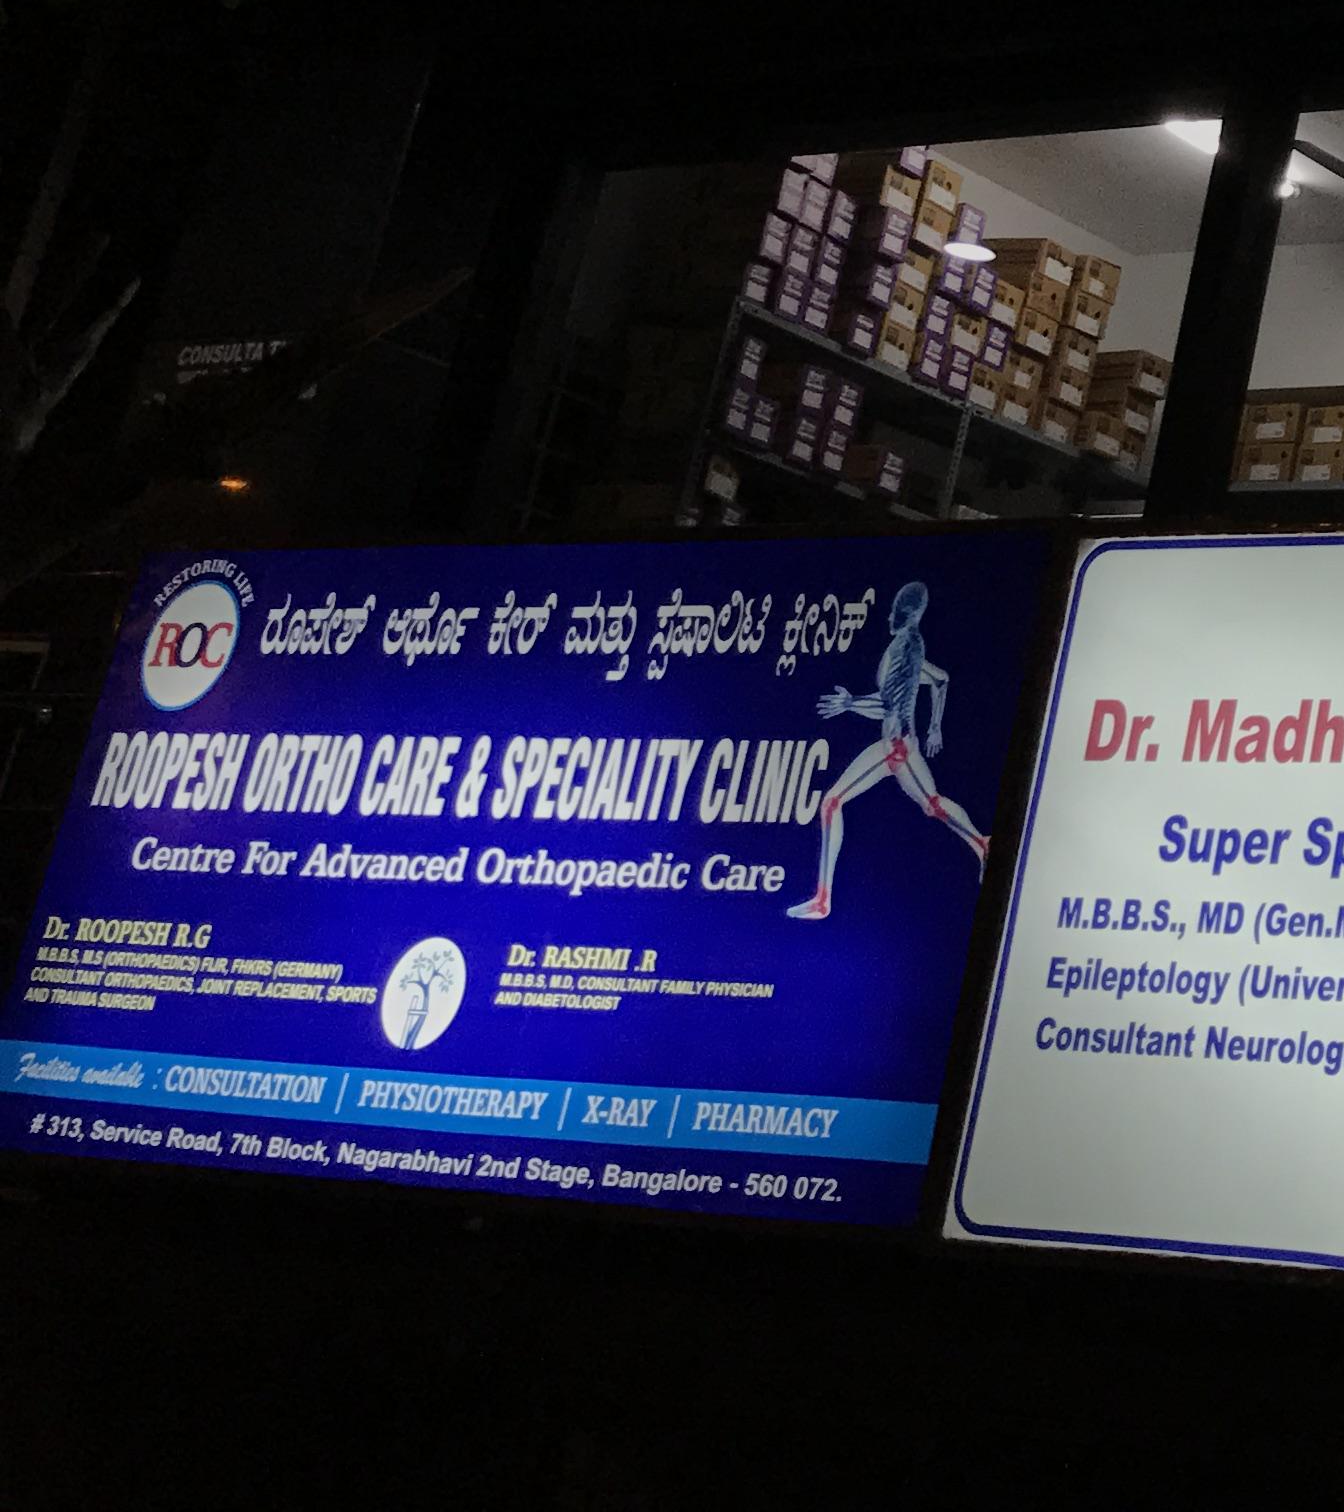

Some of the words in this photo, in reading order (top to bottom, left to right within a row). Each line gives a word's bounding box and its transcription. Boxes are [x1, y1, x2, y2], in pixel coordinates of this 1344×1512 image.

[153, 559, 238, 607] RESTORING
[233, 571, 256, 608] LIFE
[148, 622, 234, 668] ROC
[1085, 699, 1157, 761] Dr.
[90, 730, 251, 812] ROOPESH
[242, 732, 364, 816] ORTHO
[358, 734, 463, 817] CARE
[454, 734, 492, 819] &
[490, 735, 704, 822] SPECIALITY
[698, 737, 830, 826] CLINIC
[131, 836, 236, 874] Centre
[240, 840, 298, 876] For
[298, 842, 470, 883] Advanced
[475, 847, 691, 897] Orthopaedic
[701, 853, 785, 892] Care
[1157, 813, 1292, 877] Super
[74, 917, 173, 946] ROOPESH
[172, 923, 213, 949] R.G
[1056, 895, 1185, 937] M.B.B.S.,
[1195, 900, 1246, 936] MD
[273, 960, 344, 984] (GERMANY)
[541, 945, 633, 971] RASHMI
[1045, 955, 1230, 1005] Epileptology
[30, 966, 105, 987] CONSULTANT
[233, 980, 324, 1004] REPLACEMENT,
[326, 985, 378, 1004] SPORTS
[50, 989, 98, 1007] TRAUMA
[98, 992, 157, 1011] SURGEON
[522, 992, 622, 1011] DIABETOLOGIST
[577, 974, 661, 994] CONSULTANT
[659, 979, 705, 996] FAMILY
[705, 981, 775, 999] PHYSICIAN
[1035, 1016, 1197, 1058] Consultant
[15, 1052, 78, 1083] Facilities
[165, 1065, 327, 1103] CONSULTATION
[357, 1079, 549, 1120] PHYSIOTHERAPY
[581, 1095, 657, 1127] X-RAY
[692, 1102, 838, 1138] PHARMACY
[46, 1115, 85, 1143] 313,
[89, 1119, 163, 1147] Service
[165, 1127, 223, 1157] Road,
[230, 1133, 263, 1156] 7th
[266, 1136, 331, 1167] Block,
[336, 1141, 475, 1176] Nagarabhavi
[475, 1154, 522, 1179] 2nd
[524, 1157, 590, 1189] Stage,
[601, 1163, 723, 1196] Bangalore
[743, 1173, 788, 1198] 560
[793, 1176, 842, 1202] 072.
